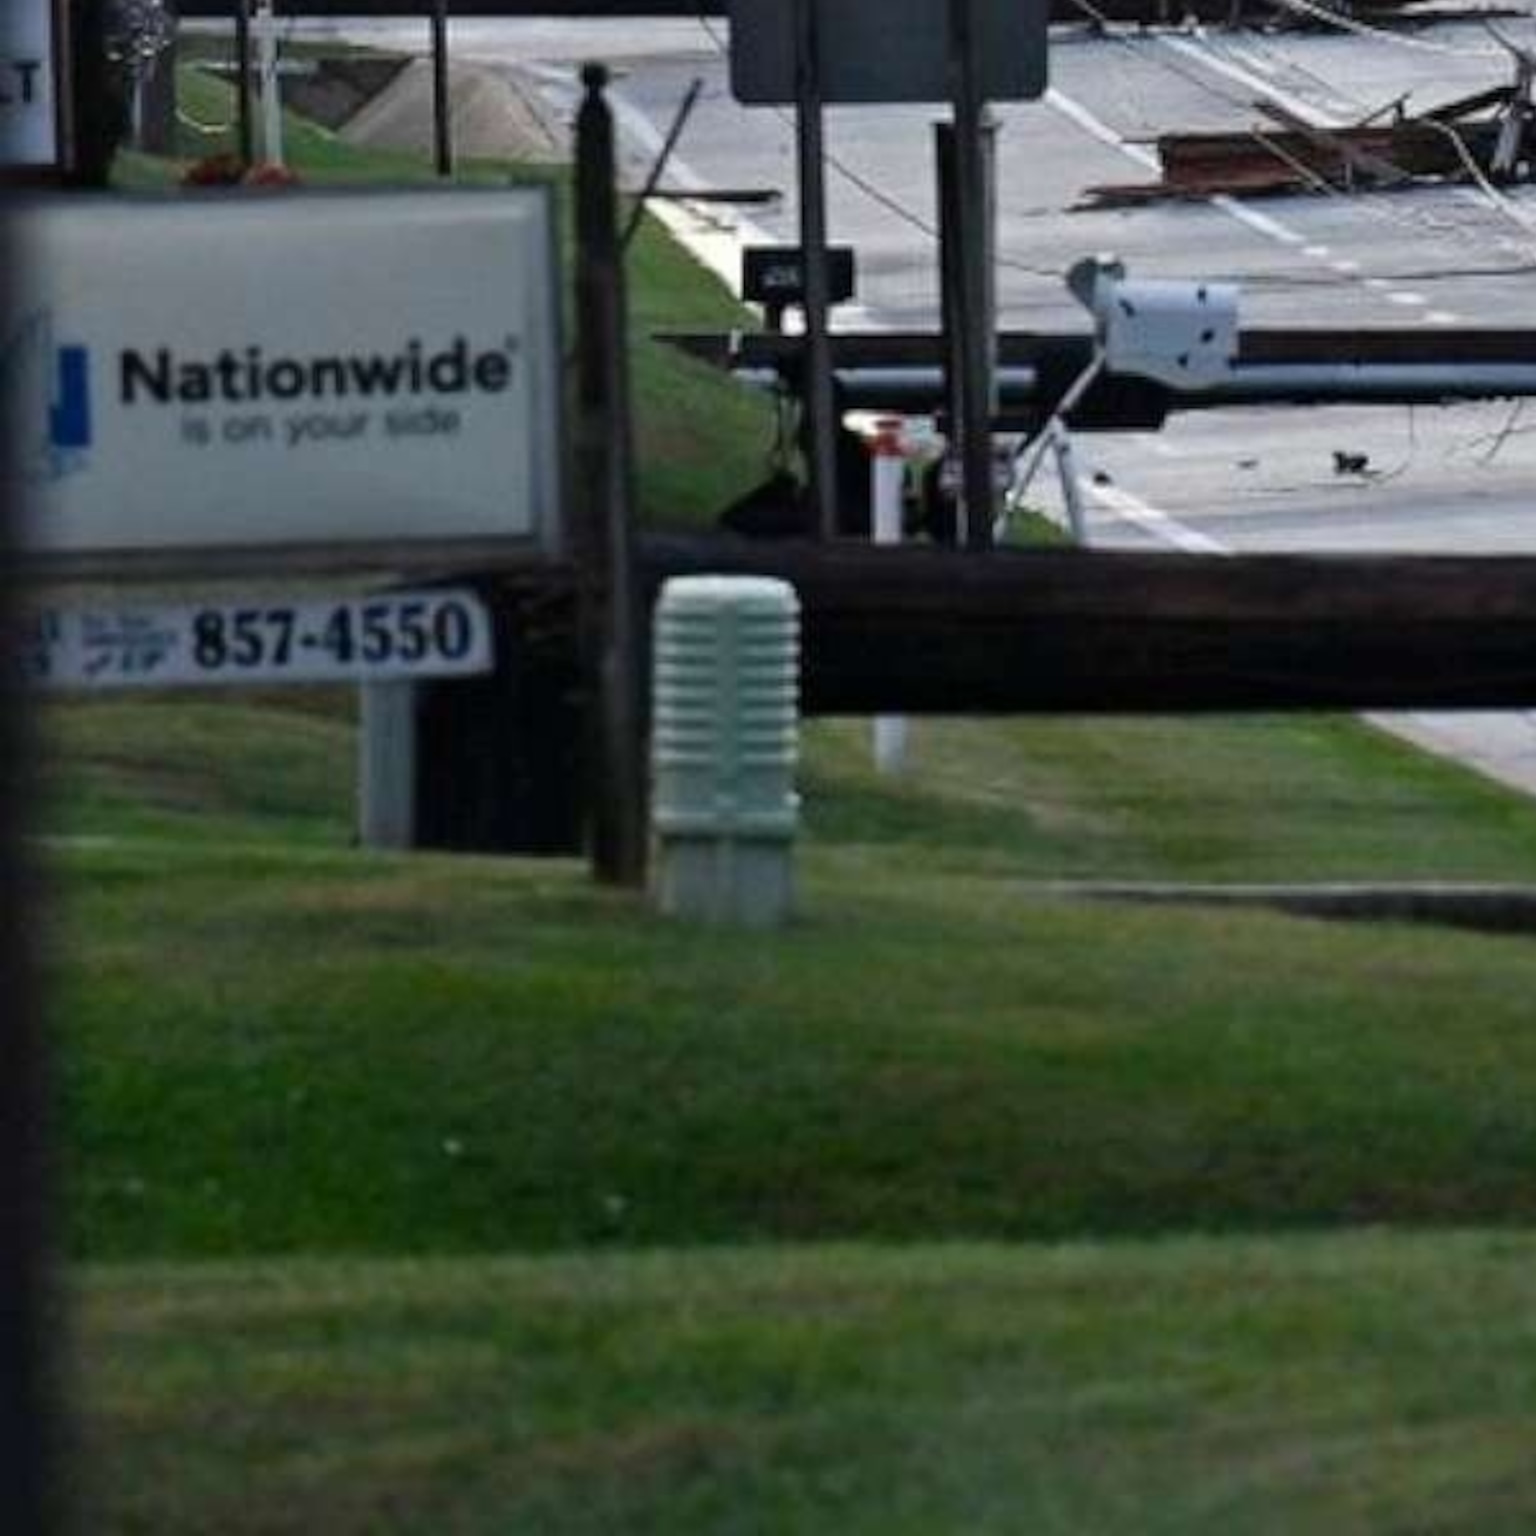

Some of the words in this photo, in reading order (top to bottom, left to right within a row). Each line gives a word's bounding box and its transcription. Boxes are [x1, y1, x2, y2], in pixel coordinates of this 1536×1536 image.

[119, 336, 512, 405] Nationwide
[181, 414, 211, 445] is
[222, 415, 273, 443] on
[286, 412, 368, 447] your
[384, 406, 462, 438] side
[193, 600, 474, 668] 857-4550
